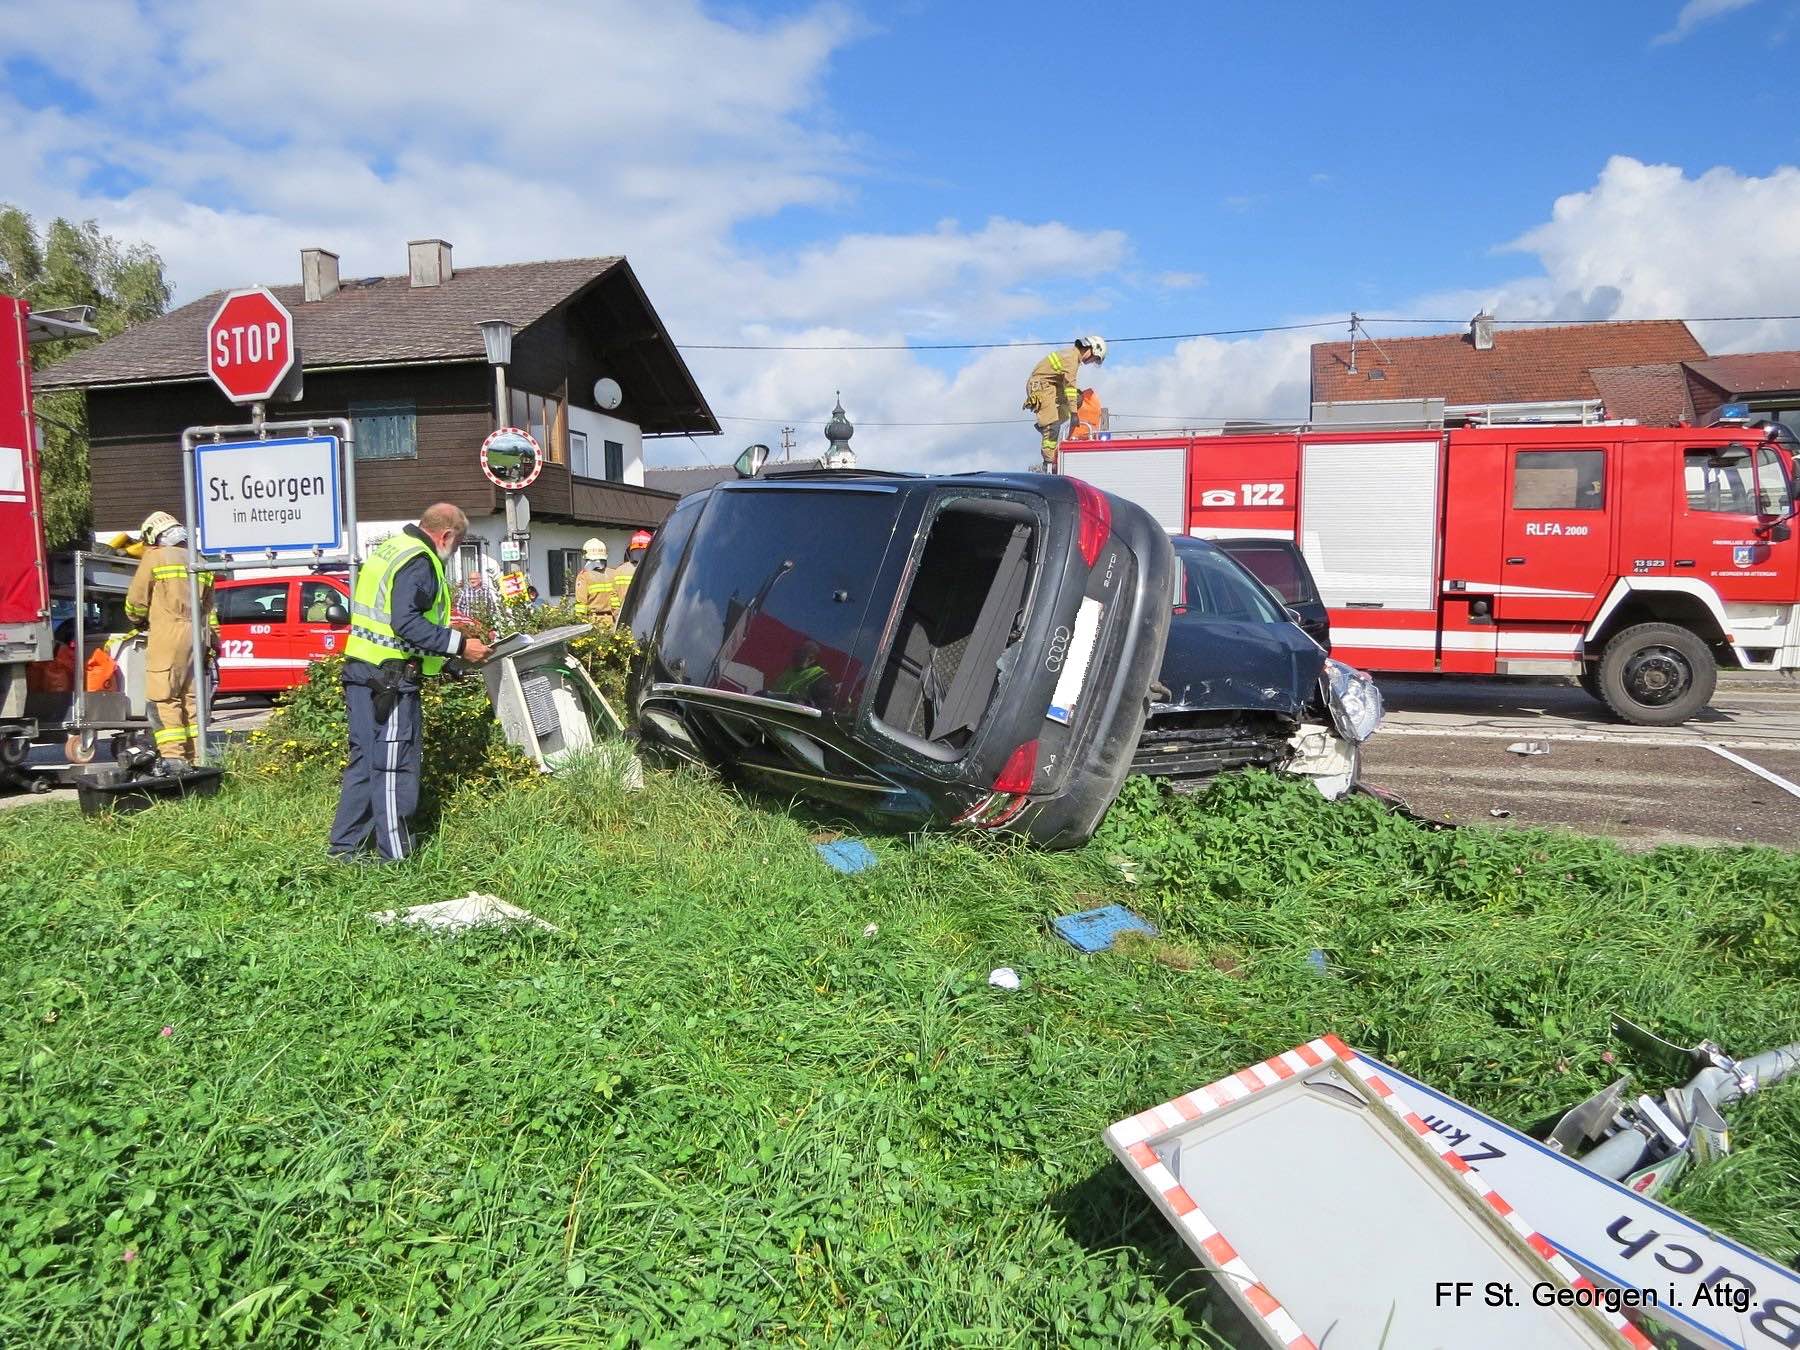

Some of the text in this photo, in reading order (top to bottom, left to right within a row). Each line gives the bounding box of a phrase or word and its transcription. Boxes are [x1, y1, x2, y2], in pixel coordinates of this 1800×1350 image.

[216, 322, 280, 367] STOP
[209, 475, 324, 502] St. Georgen
[1241, 483, 1284, 506] 122
[233, 508, 302, 524] im Attergau
[1526, 523, 1588, 536] RLFA 2000
[250, 625, 271, 635] KDO
[221, 640, 254, 659] 122
[1422, 1115, 1472, 1148] km
